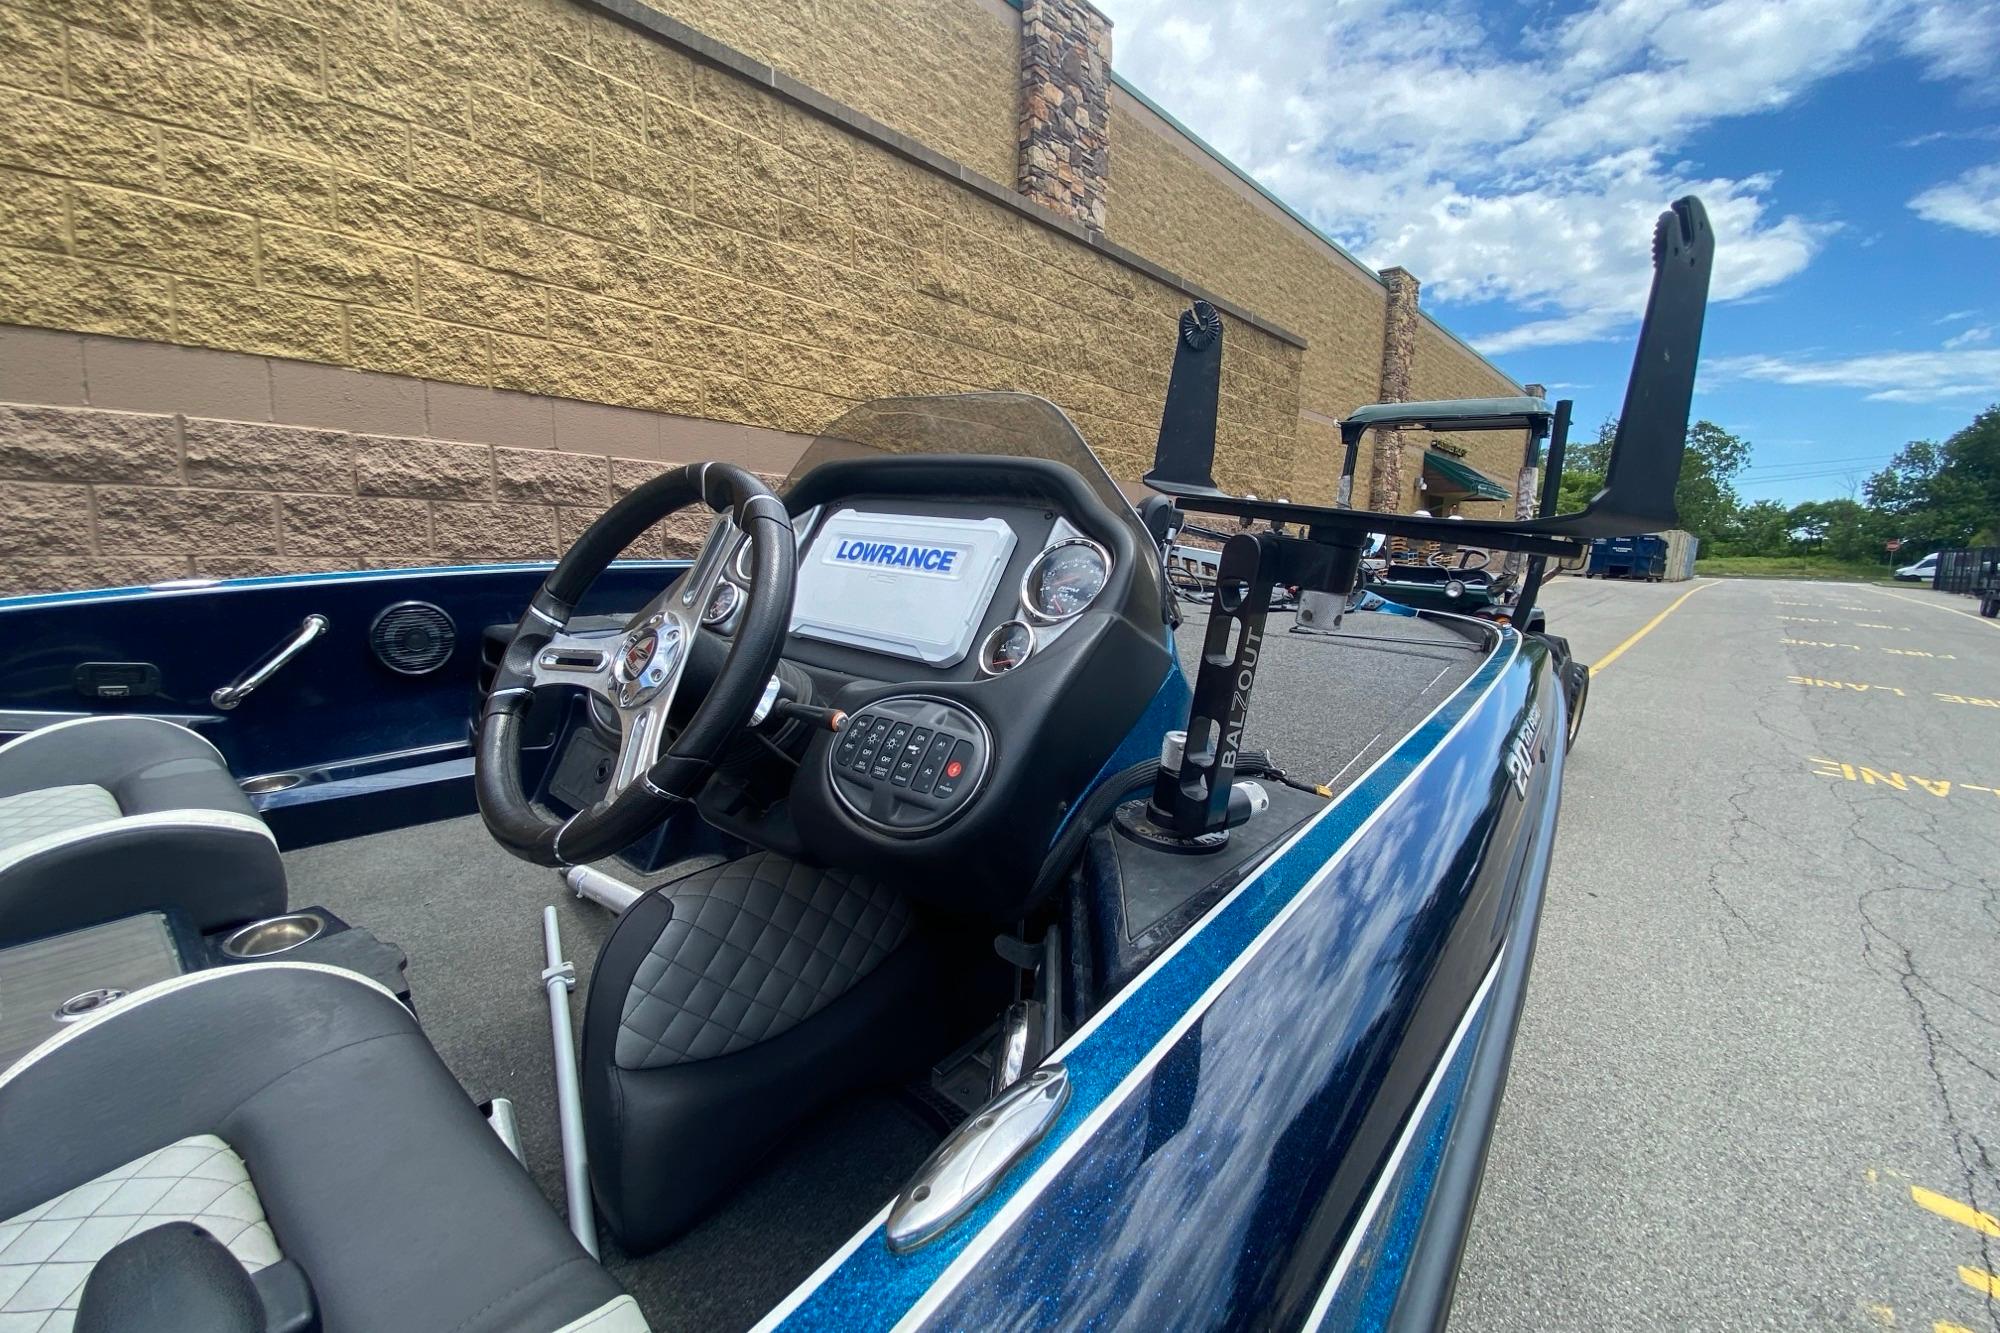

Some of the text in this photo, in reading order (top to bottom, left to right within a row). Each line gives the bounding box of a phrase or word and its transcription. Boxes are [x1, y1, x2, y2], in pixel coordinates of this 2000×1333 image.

[835, 540, 957, 573] LOWRANCE
[1220, 626, 1260, 769] BALZOUT
[1786, 675, 1906, 696] LANE
